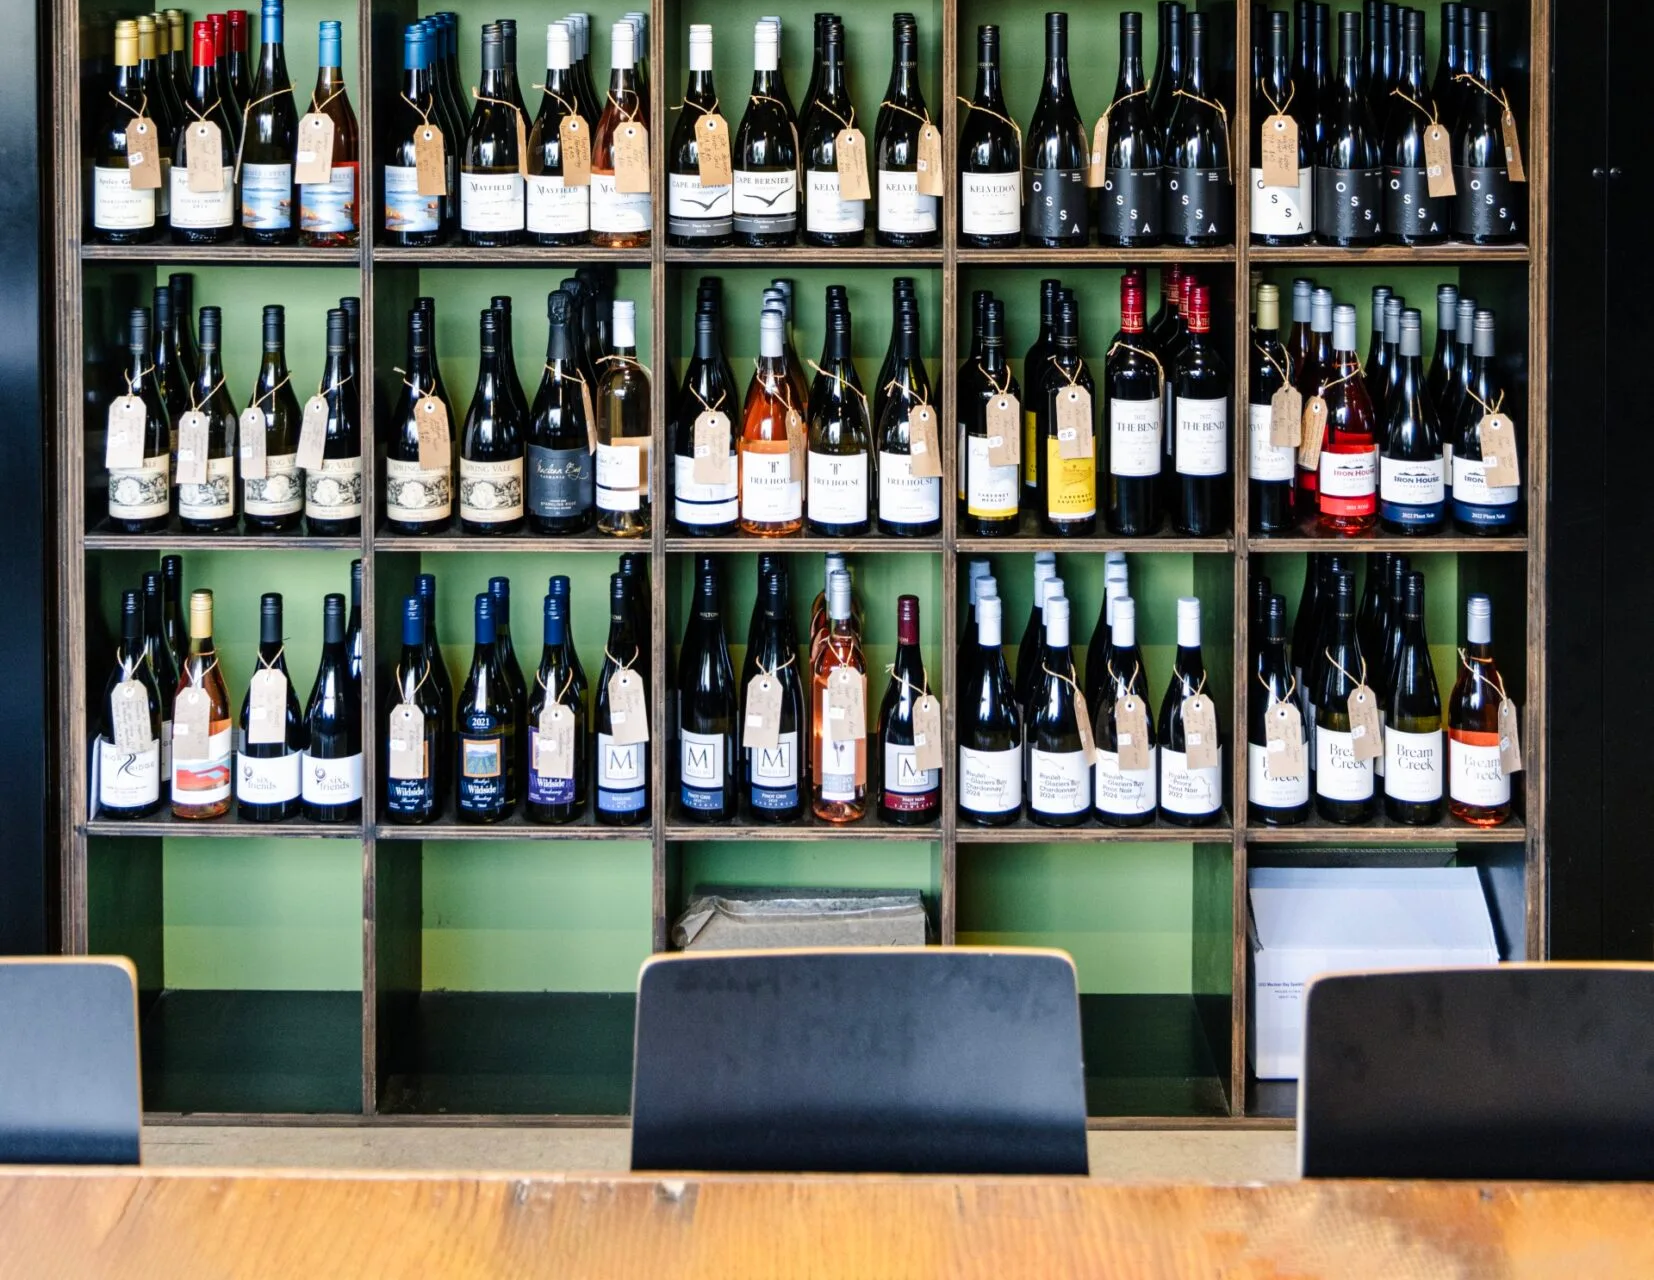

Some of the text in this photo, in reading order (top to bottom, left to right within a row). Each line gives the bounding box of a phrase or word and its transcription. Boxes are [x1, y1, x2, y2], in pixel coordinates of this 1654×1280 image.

[672, 180, 689, 189] CAPE
[735, 176, 789, 184] CAPE BERNIER
[470, 181, 512, 193] MAYFIELD
[536, 184, 578, 195] MAYFIELD
[814, 183, 840, 192] KELV
[886, 183, 918, 192] KELVE
[969, 184, 1016, 193] KELVEDON
[1033, 181, 1080, 234] OSSA
[1105, 180, 1151, 233] OSSA
[1170, 180, 1217, 233] OSSA
[1257, 180, 1304, 230] OSSA
[1335, 181, 1381, 233] OSSA
[1390, 179, 1438, 232] OSSA
[1470, 180, 1516, 231] OSSA
[1117, 421, 1159, 432] THE BEND
[1182, 421, 1225, 431] THE BEND
[493, 464, 512, 472] VALE
[1333, 469, 1354, 477] IRON
[750, 476, 791, 485] TREEHOU
[814, 477, 859, 486] TREEHOUSE
[887, 477, 933, 486] TREEHOUSE
[1394, 475, 1439, 483] IRON HOUSE
[1464, 475, 1484, 483] IRON
[472, 717, 490, 726] 2021
[1330, 743, 1353, 756] Brea
[1397, 744, 1433, 758] Bream
[610, 749, 632, 769] M
[688, 747, 708, 769] M
[762, 748, 784, 768] M
[1331, 756, 1367, 770] Creek
[1464, 754, 1500, 768] Bream
[903, 757, 925, 777] M
[1398, 758, 1434, 772] Creek
[1465, 768, 1502, 781] Creek
[248, 781, 277, 790] friends
[320, 781, 350, 791] friends
[538, 778, 565, 788] Wildside
[966, 783, 1002, 792] Chardonnay
[395, 786, 424, 797] Wildside
[468, 784, 497, 795] Wildside
[1039, 785, 1076, 793] Chardonnay
